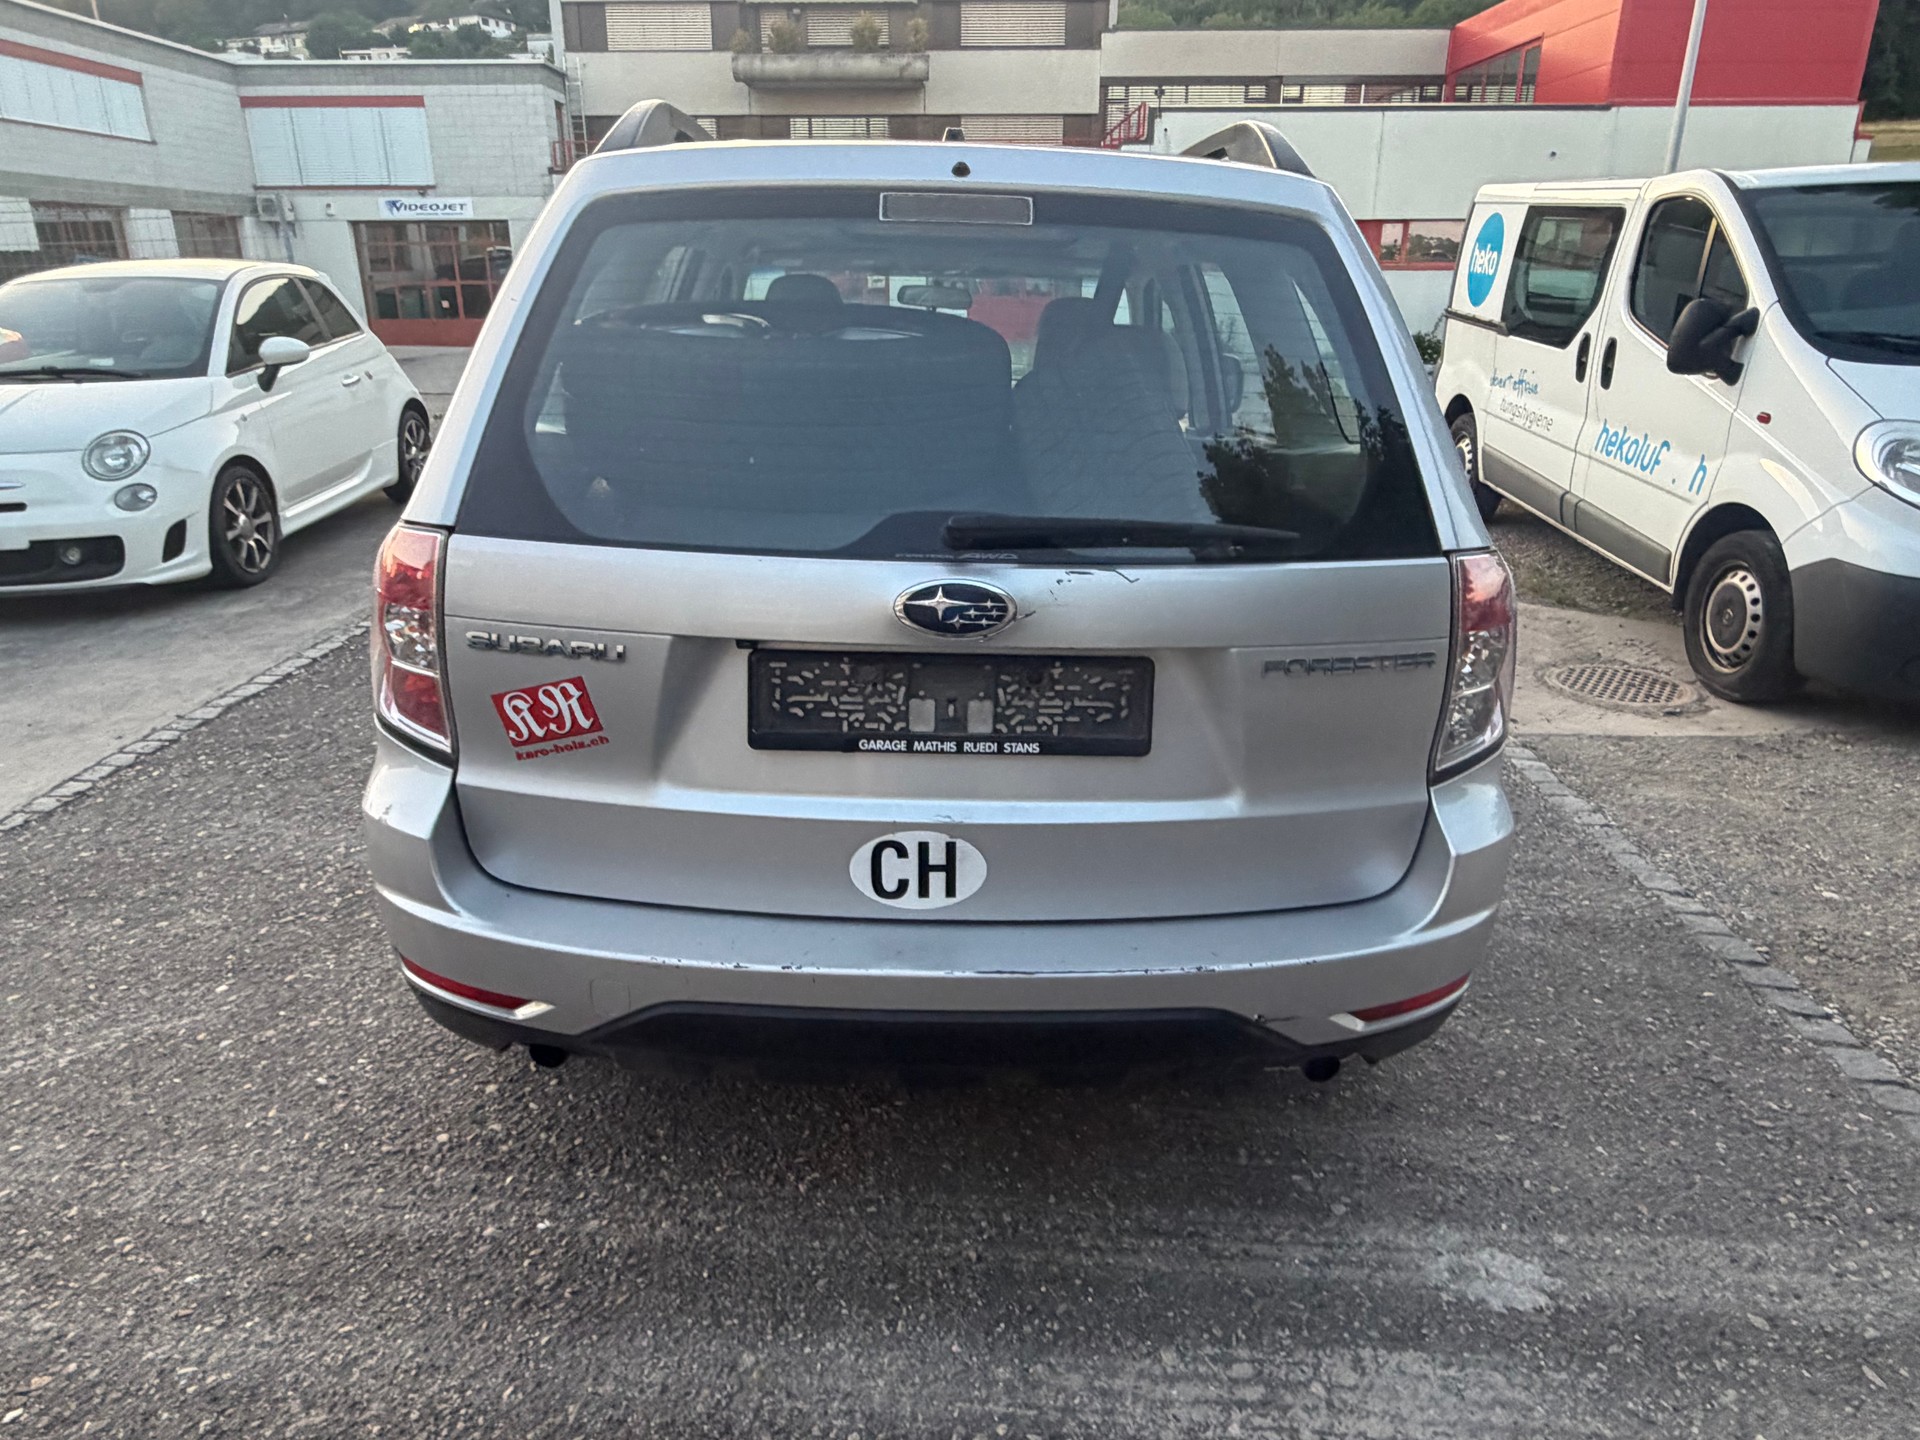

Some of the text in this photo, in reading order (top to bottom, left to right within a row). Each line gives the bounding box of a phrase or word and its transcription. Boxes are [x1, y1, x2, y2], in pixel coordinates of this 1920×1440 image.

[387, 200, 467, 212] VIDEOJET
[1470, 242, 1498, 276] heko
[465, 631, 626, 662] SUBARU
[1262, 651, 1437, 678] FORESTER
[515, 735, 610, 761] karo-holz.ch
[858, 739, 1040, 754] GARAGE MATHIS RUEDI STANS
[870, 840, 957, 900] CH
